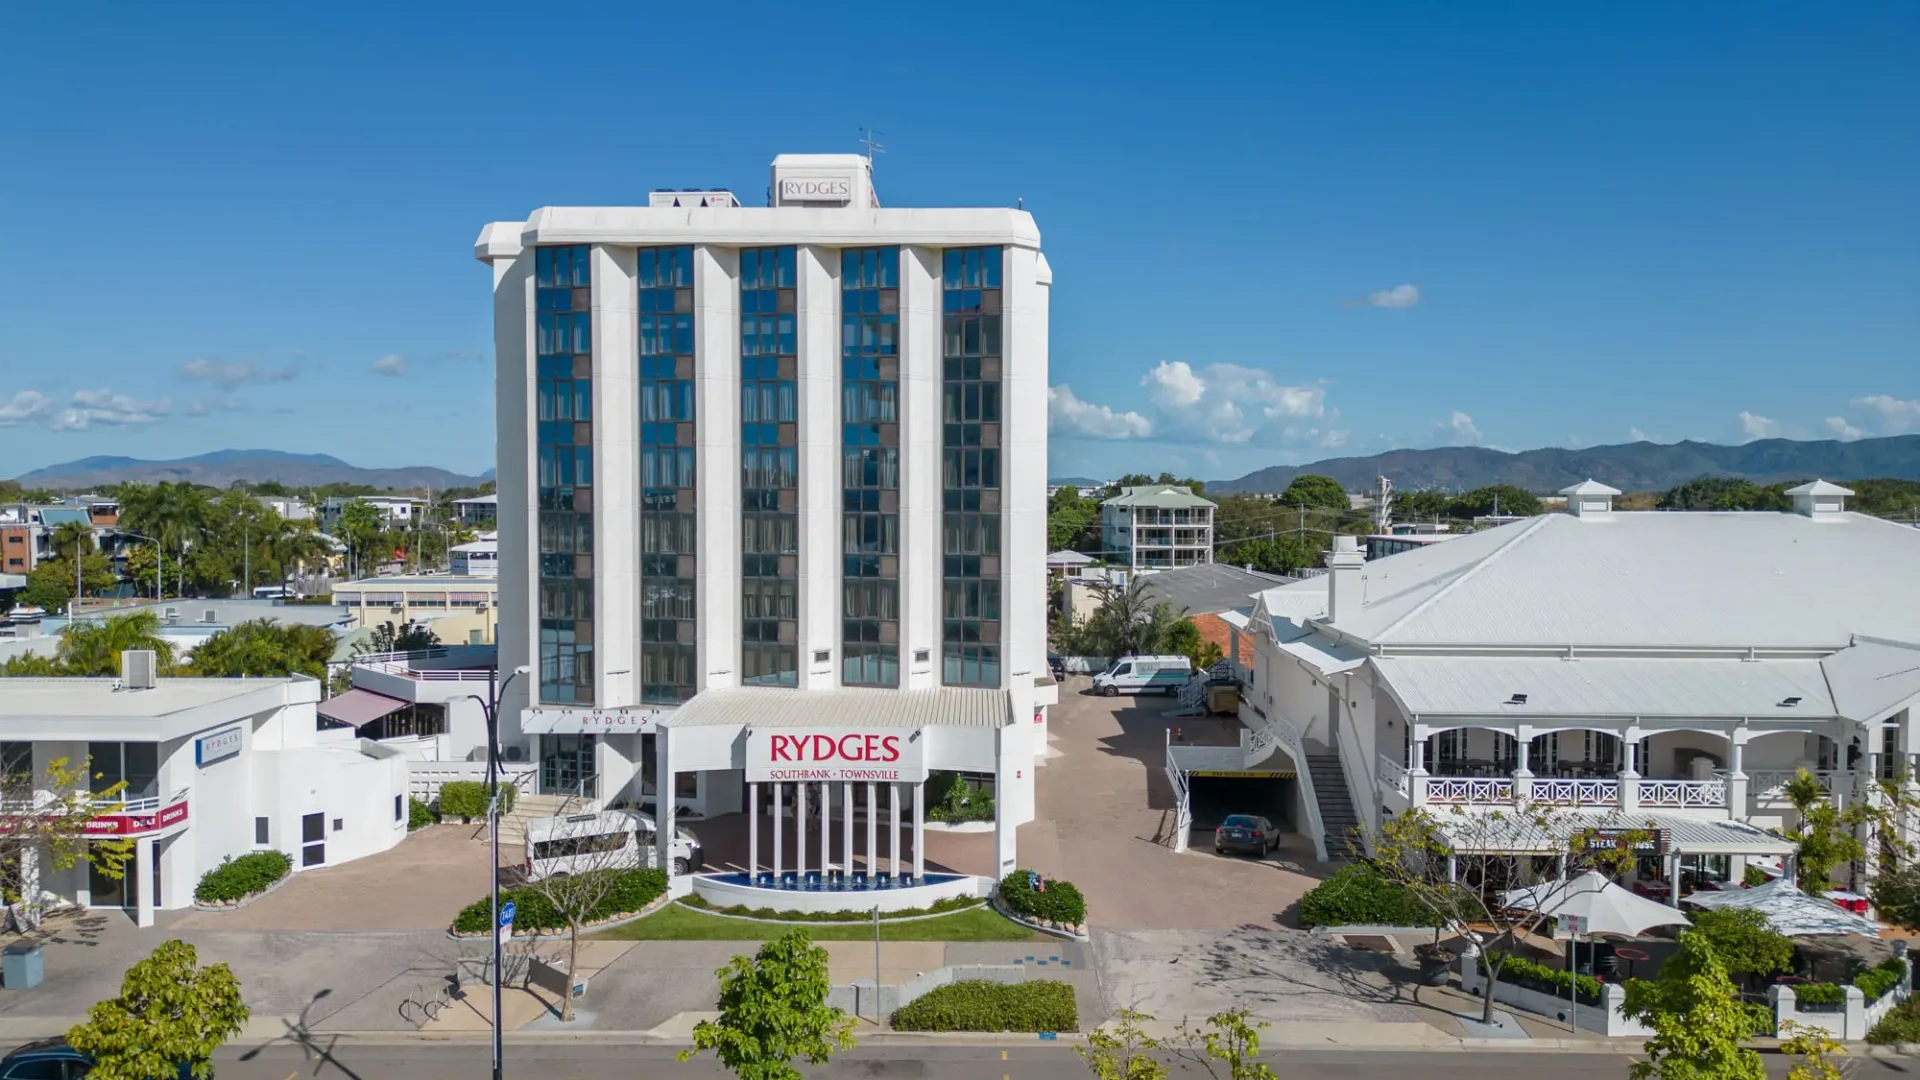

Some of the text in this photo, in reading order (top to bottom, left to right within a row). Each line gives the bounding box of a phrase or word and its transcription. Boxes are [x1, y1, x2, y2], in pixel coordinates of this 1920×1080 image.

[785, 182, 848, 194] RYDGES
[582, 716, 648, 725] RYDGES
[771, 734, 900, 762] RYDGES
[770, 769, 899, 780] SOUTHBANK TOWNSVILLE
[162, 808, 183, 822] DRINKS
[86, 821, 119, 829] DRINKS
[133, 817, 156, 828] DELI
[1589, 839, 1617, 849] STEAK
